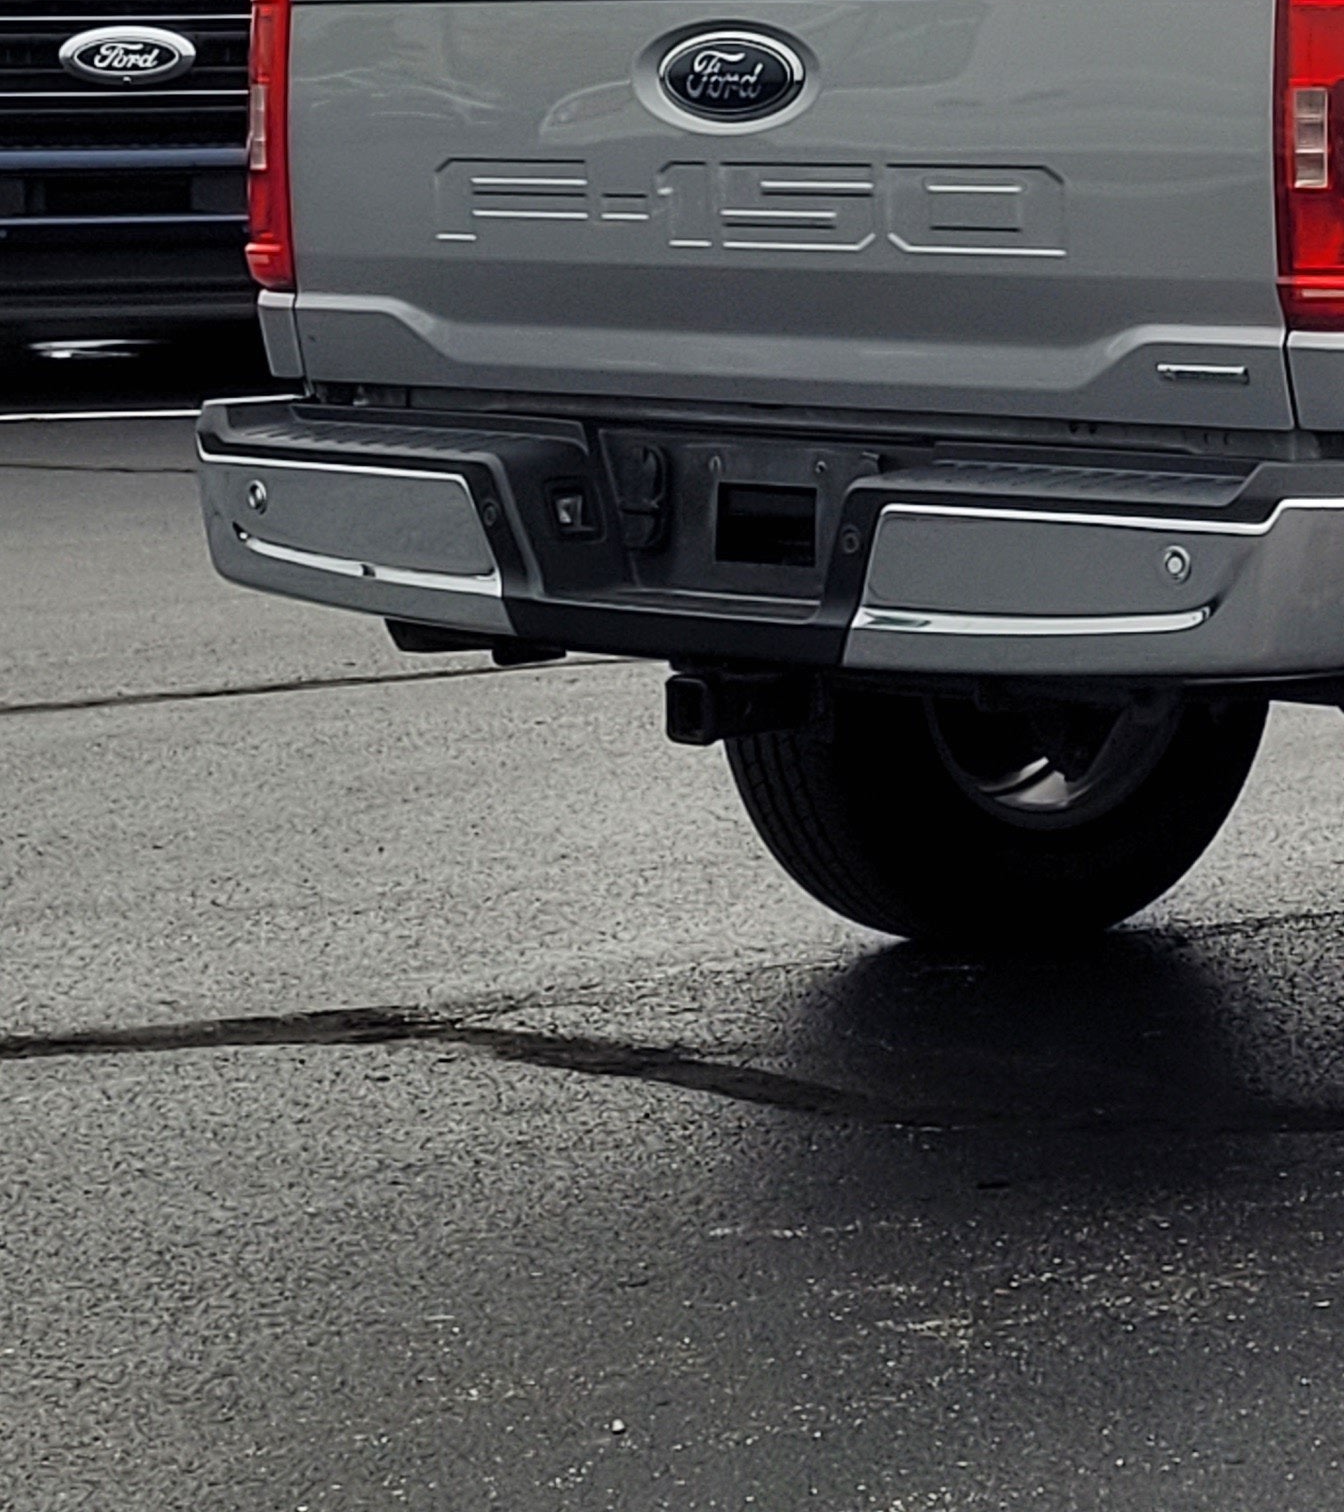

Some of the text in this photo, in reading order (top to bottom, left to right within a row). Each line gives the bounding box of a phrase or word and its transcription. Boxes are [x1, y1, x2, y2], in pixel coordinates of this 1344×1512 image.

[93, 42, 160, 69] Ford
[685, 50, 764, 99] Ford
[434, 157, 1067, 258] F-150
